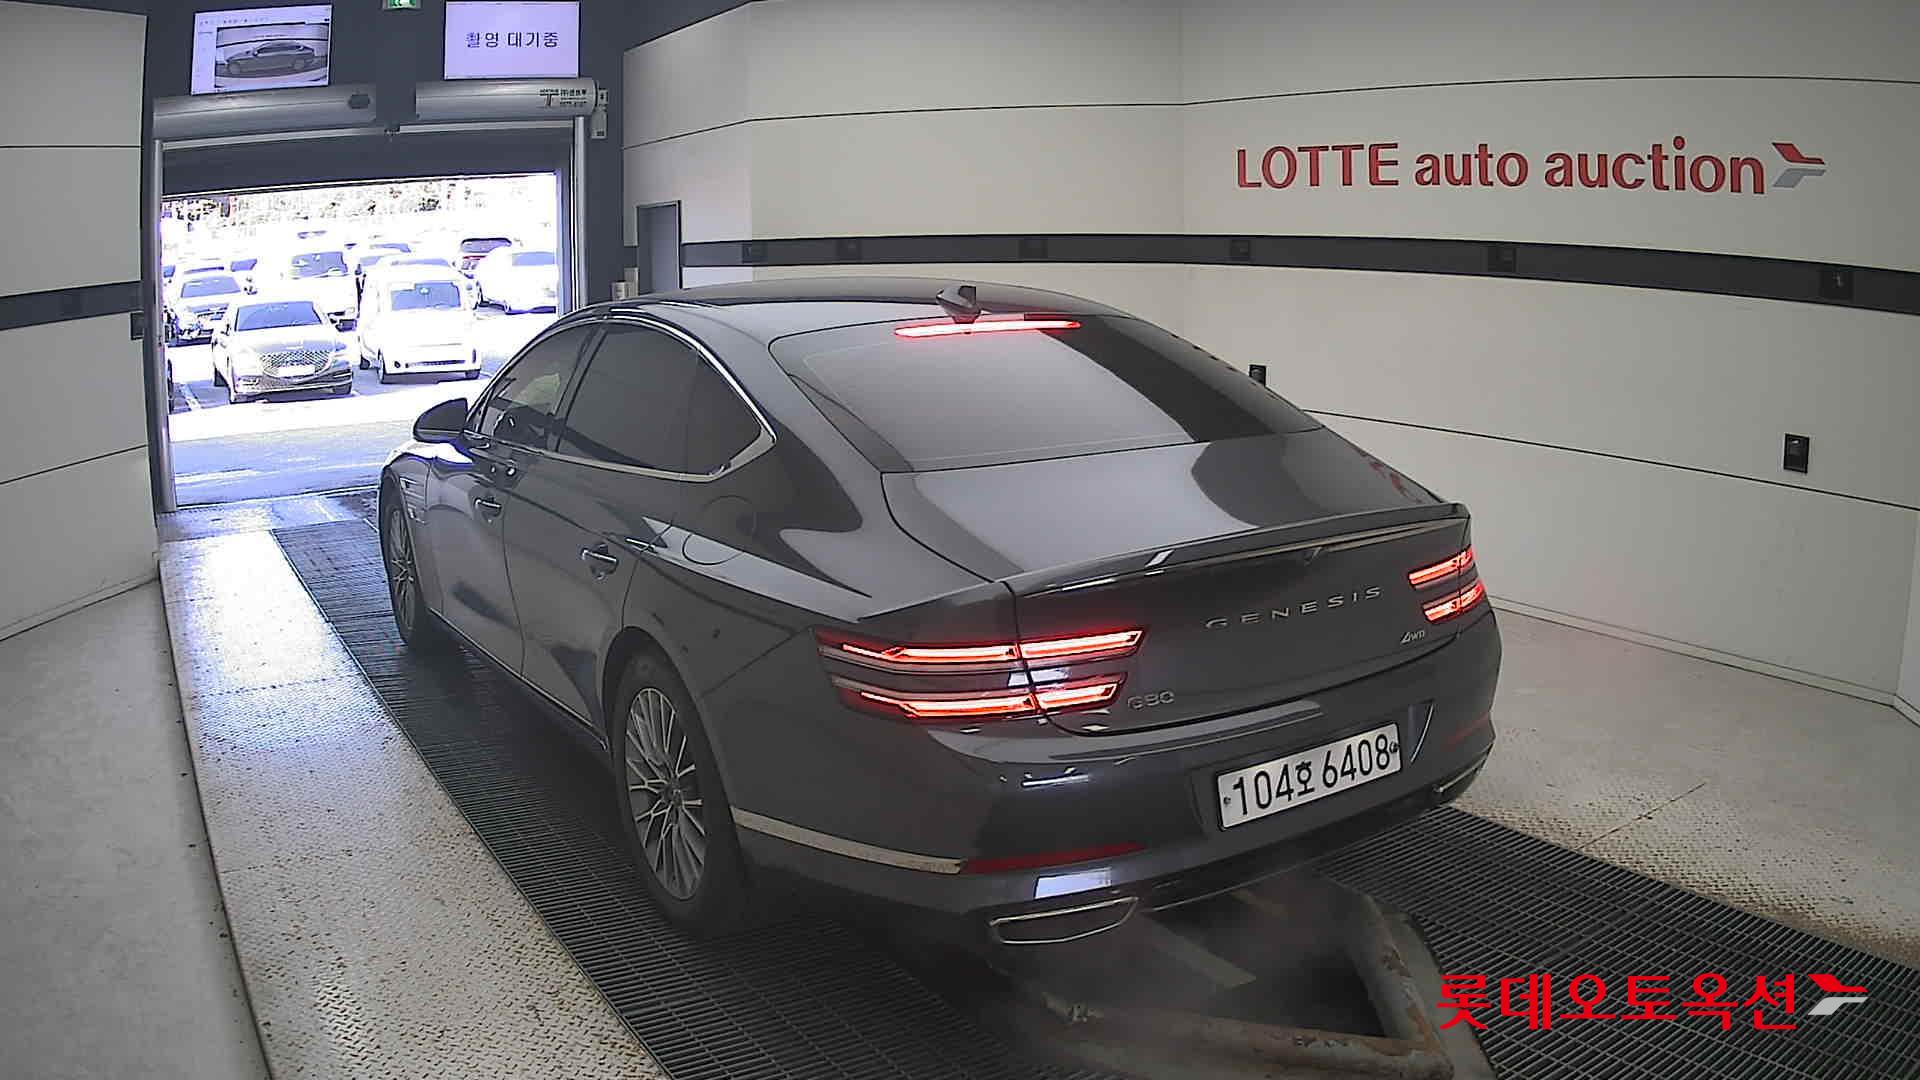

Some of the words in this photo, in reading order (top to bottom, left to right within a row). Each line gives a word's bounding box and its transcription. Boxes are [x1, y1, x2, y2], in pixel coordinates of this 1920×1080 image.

[507, 31, 559, 48] 대기중
[1237, 143, 1400, 189] LOTTE
[1414, 143, 1529, 187] auto
[1544, 136, 1765, 195] auction
[1205, 585, 1381, 629] GENESIS
[1127, 690, 1175, 710] G80
[1232, 760, 1315, 815] 104호
[1322, 733, 1390, 789] 6408
